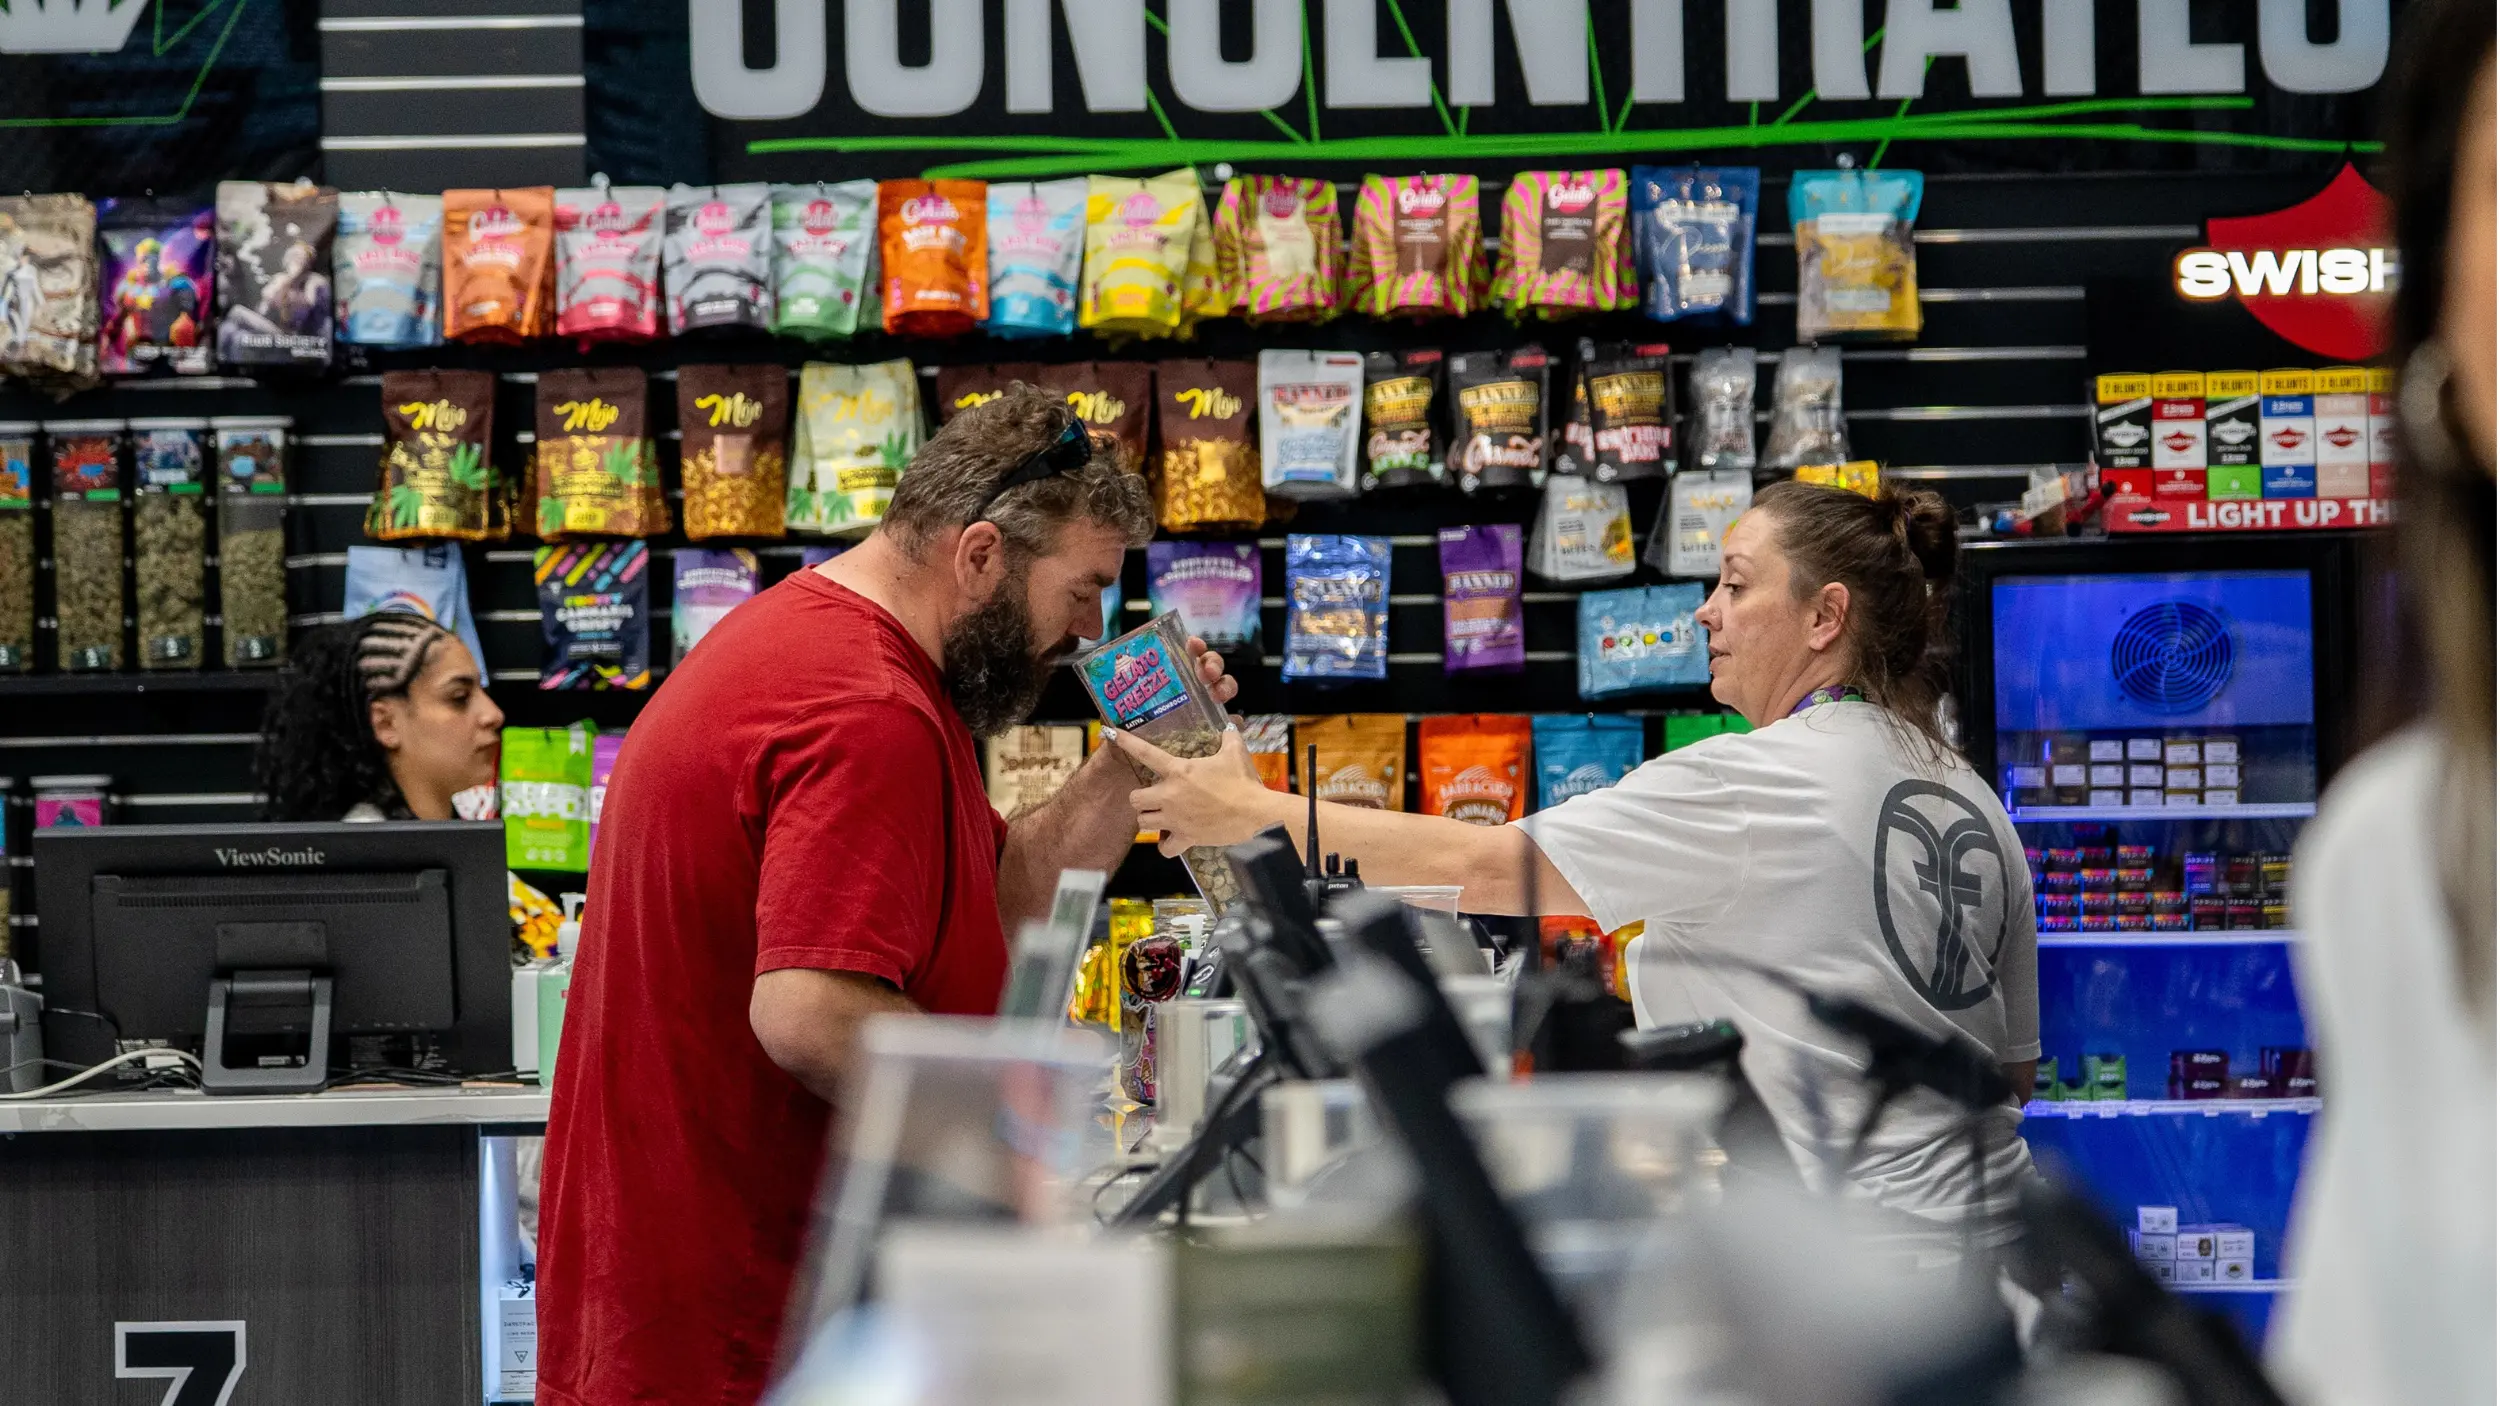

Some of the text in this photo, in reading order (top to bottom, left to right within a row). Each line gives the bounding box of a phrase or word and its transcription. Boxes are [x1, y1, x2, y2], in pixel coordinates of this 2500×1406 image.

[2188, 502, 2287, 528] LIGHT
[2296, 501, 2340, 525] UP
[555, 604, 634, 622] CANNABIS
[565, 618, 624, 633] CRISPY
[1103, 647, 1160, 701] GELATO
[1114, 667, 1172, 721] FREEZE
[1125, 694, 1188, 730] SATIVA MOONROCKS
[214, 847, 325, 866] ViewSonic
[115, 1320, 246, 1406] 7
